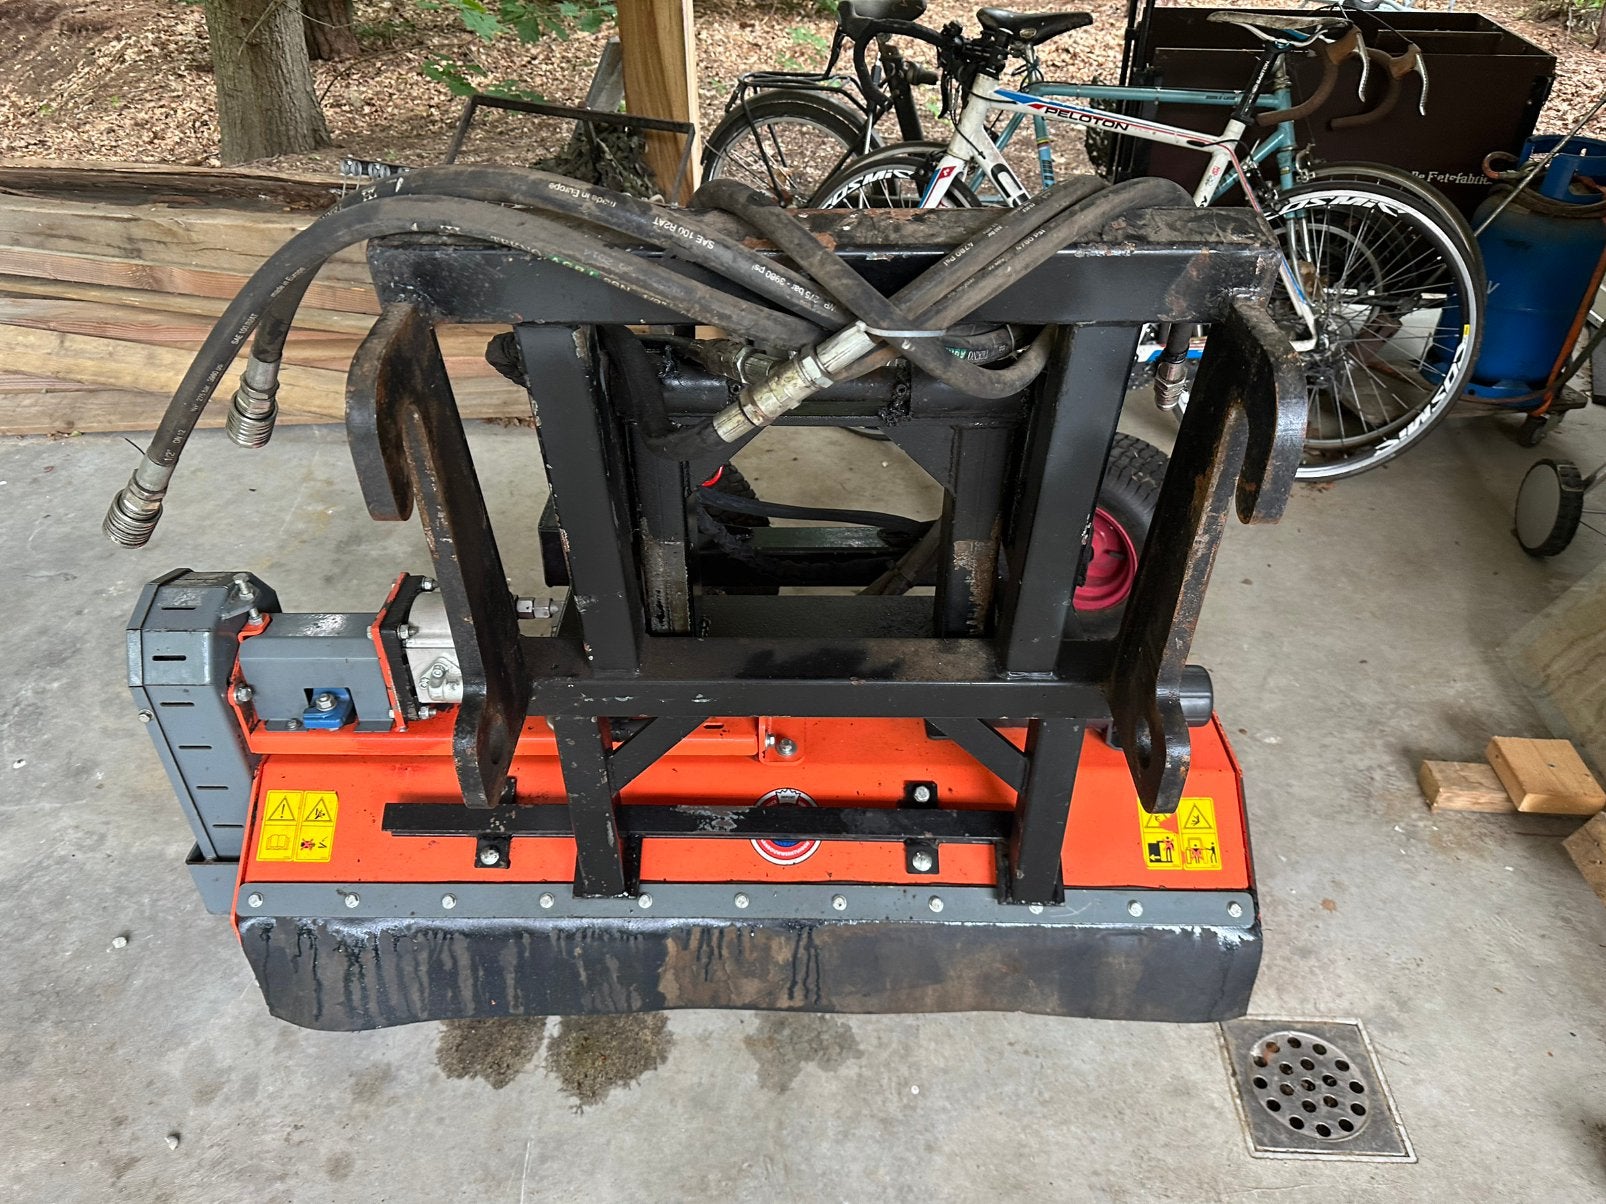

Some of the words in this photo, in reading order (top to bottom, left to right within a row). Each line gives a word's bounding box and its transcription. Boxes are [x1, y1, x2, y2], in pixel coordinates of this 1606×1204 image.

[1044, 106, 1130, 131] PELOTON
[548, 182, 581, 198] Europe
[652, 216, 678, 232] R2AT
[677, 227, 694, 240] 100
[695, 234, 716, 250] SAE
[751, 263, 766, 275] psi
[790, 282, 805, 296] bar
[230, 332, 245, 346] SAE
